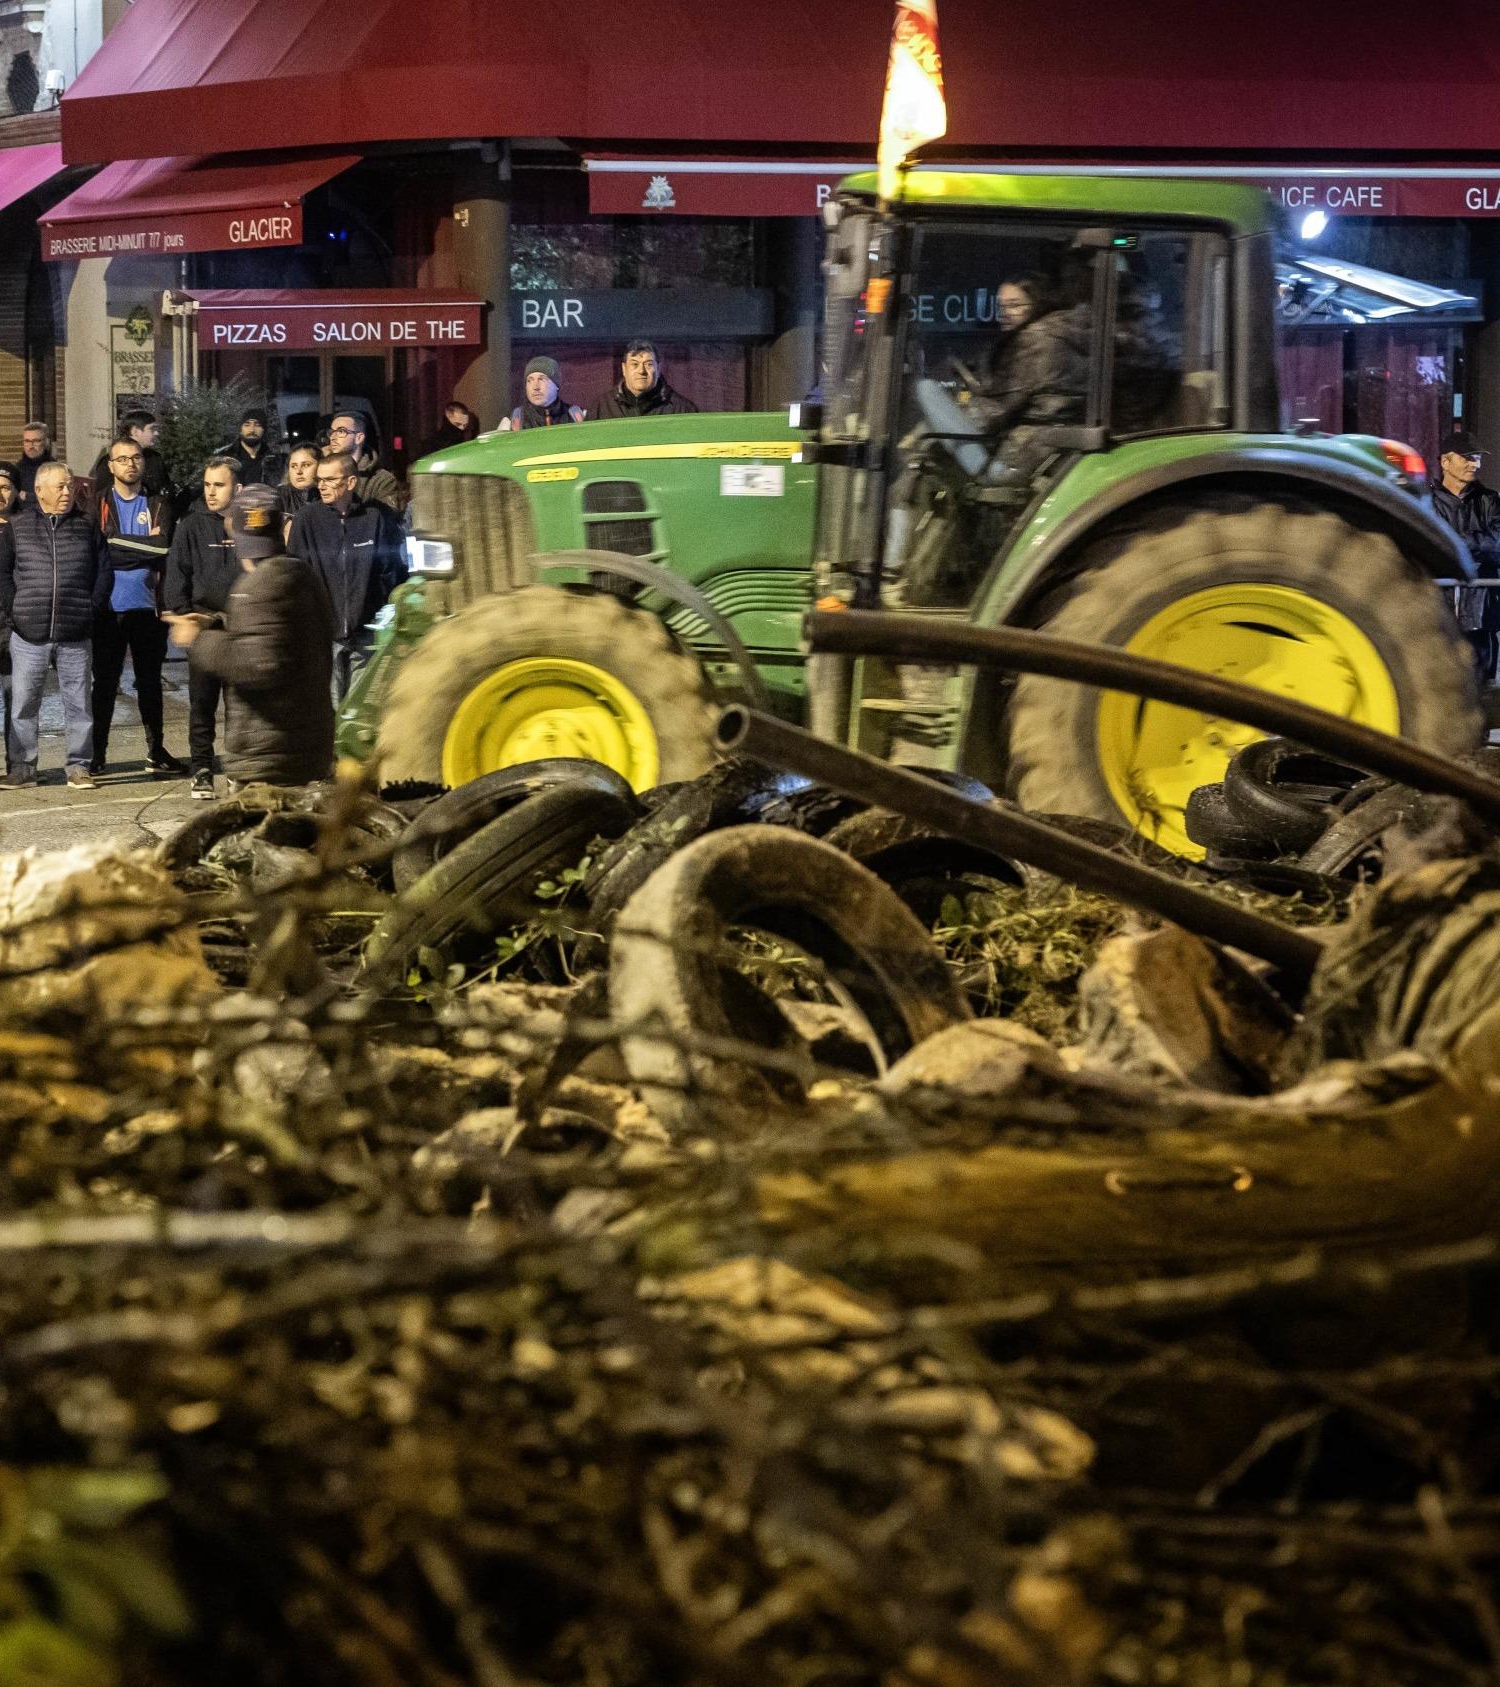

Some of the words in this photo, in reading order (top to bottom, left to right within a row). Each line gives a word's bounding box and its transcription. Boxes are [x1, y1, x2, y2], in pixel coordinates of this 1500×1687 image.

[1326, 186, 1383, 208] CAFE
[229, 217, 292, 243] GLACIER
[50, 237, 97, 255] BRASSERIE
[99, 233, 146, 251] MIDI-MINUIT
[163, 232, 184, 251] jours
[522, 299, 585, 328] BAR
[213, 324, 287, 343] PIZZAS
[312, 322, 381, 342] SALON
[390, 321, 417, 340] DE
[426, 320, 466, 339] THE
